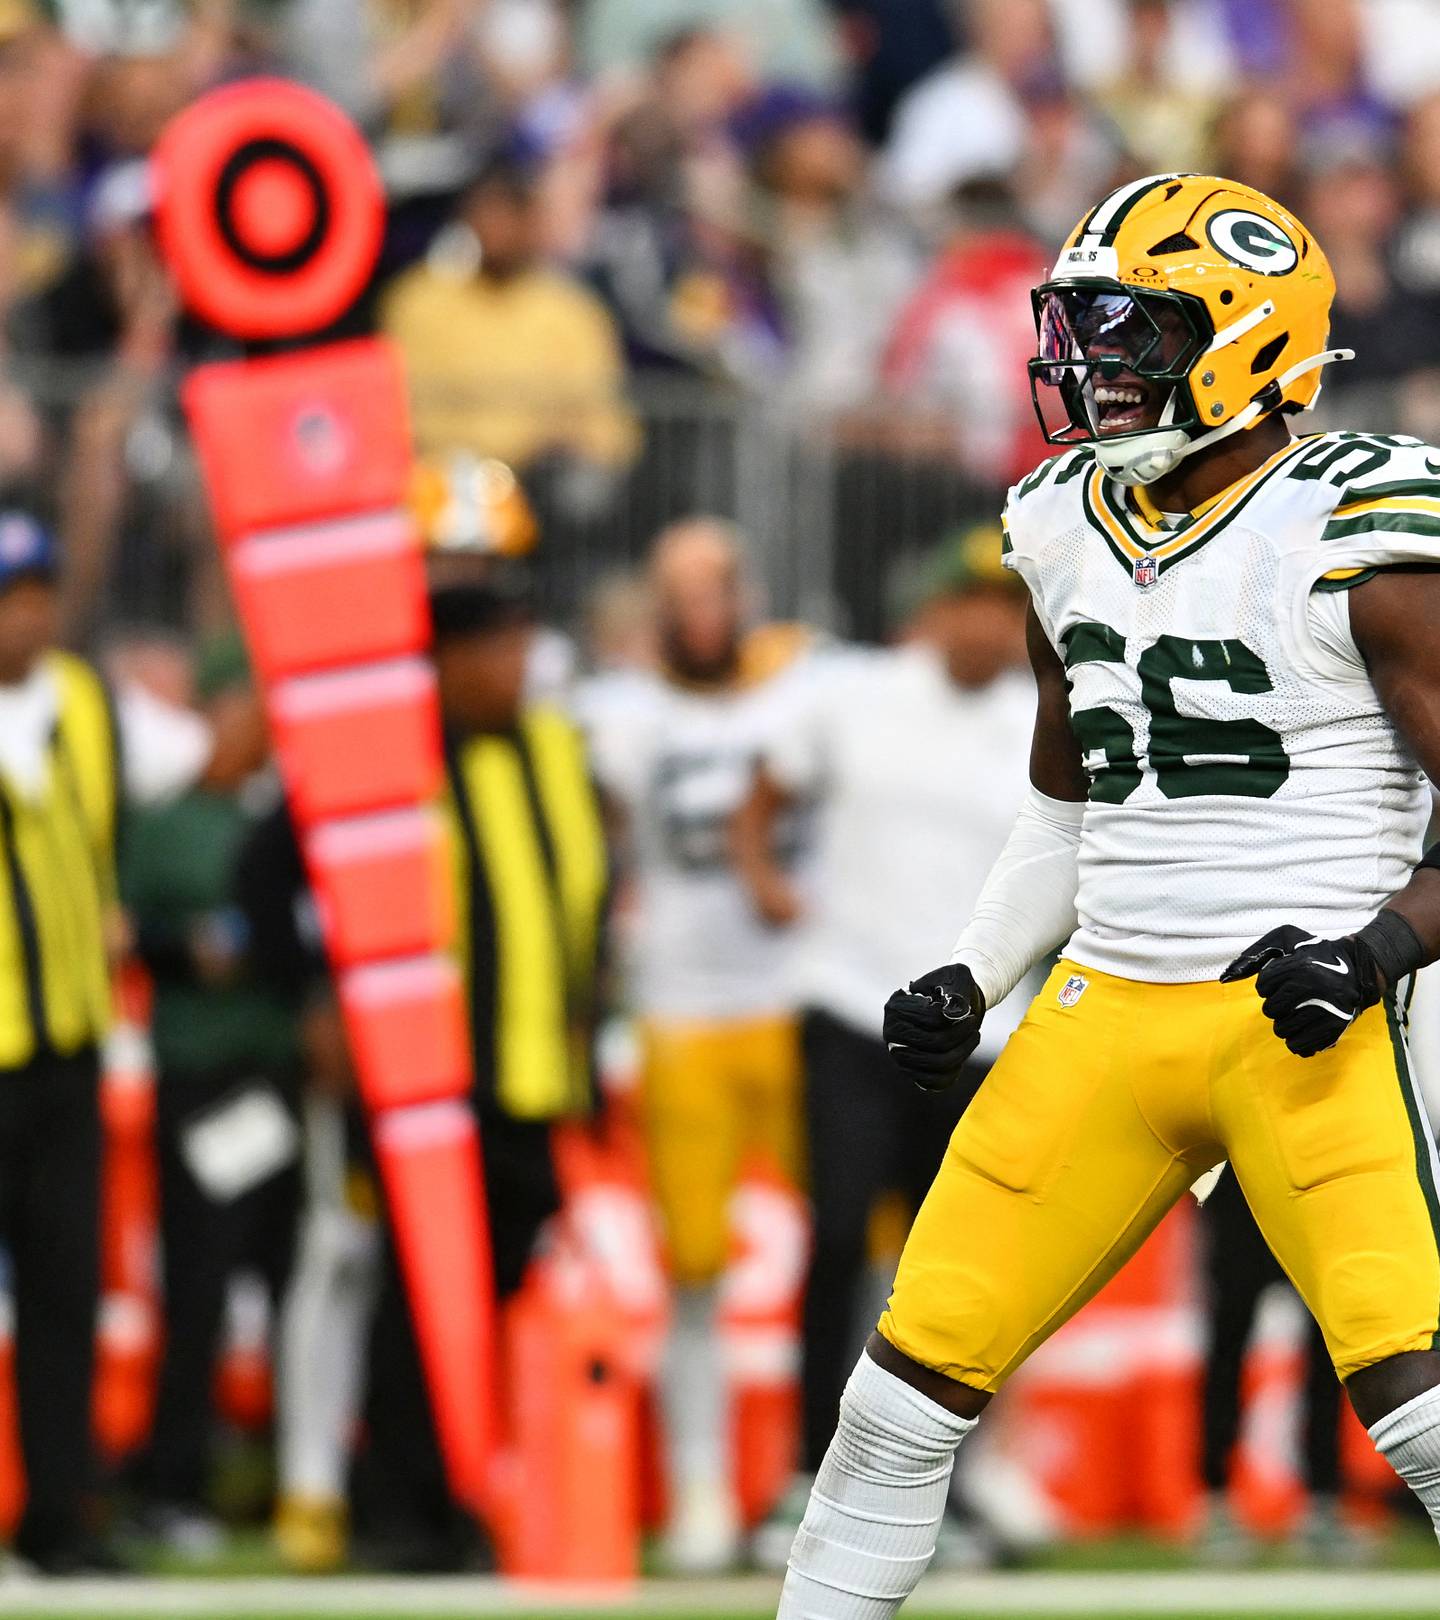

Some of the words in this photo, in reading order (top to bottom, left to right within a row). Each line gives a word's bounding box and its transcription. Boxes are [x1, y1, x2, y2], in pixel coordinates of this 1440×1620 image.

[1205, 208, 1299, 278] G
[1136, 569, 1154, 583] NFL
[1058, 622, 1291, 805] 56
